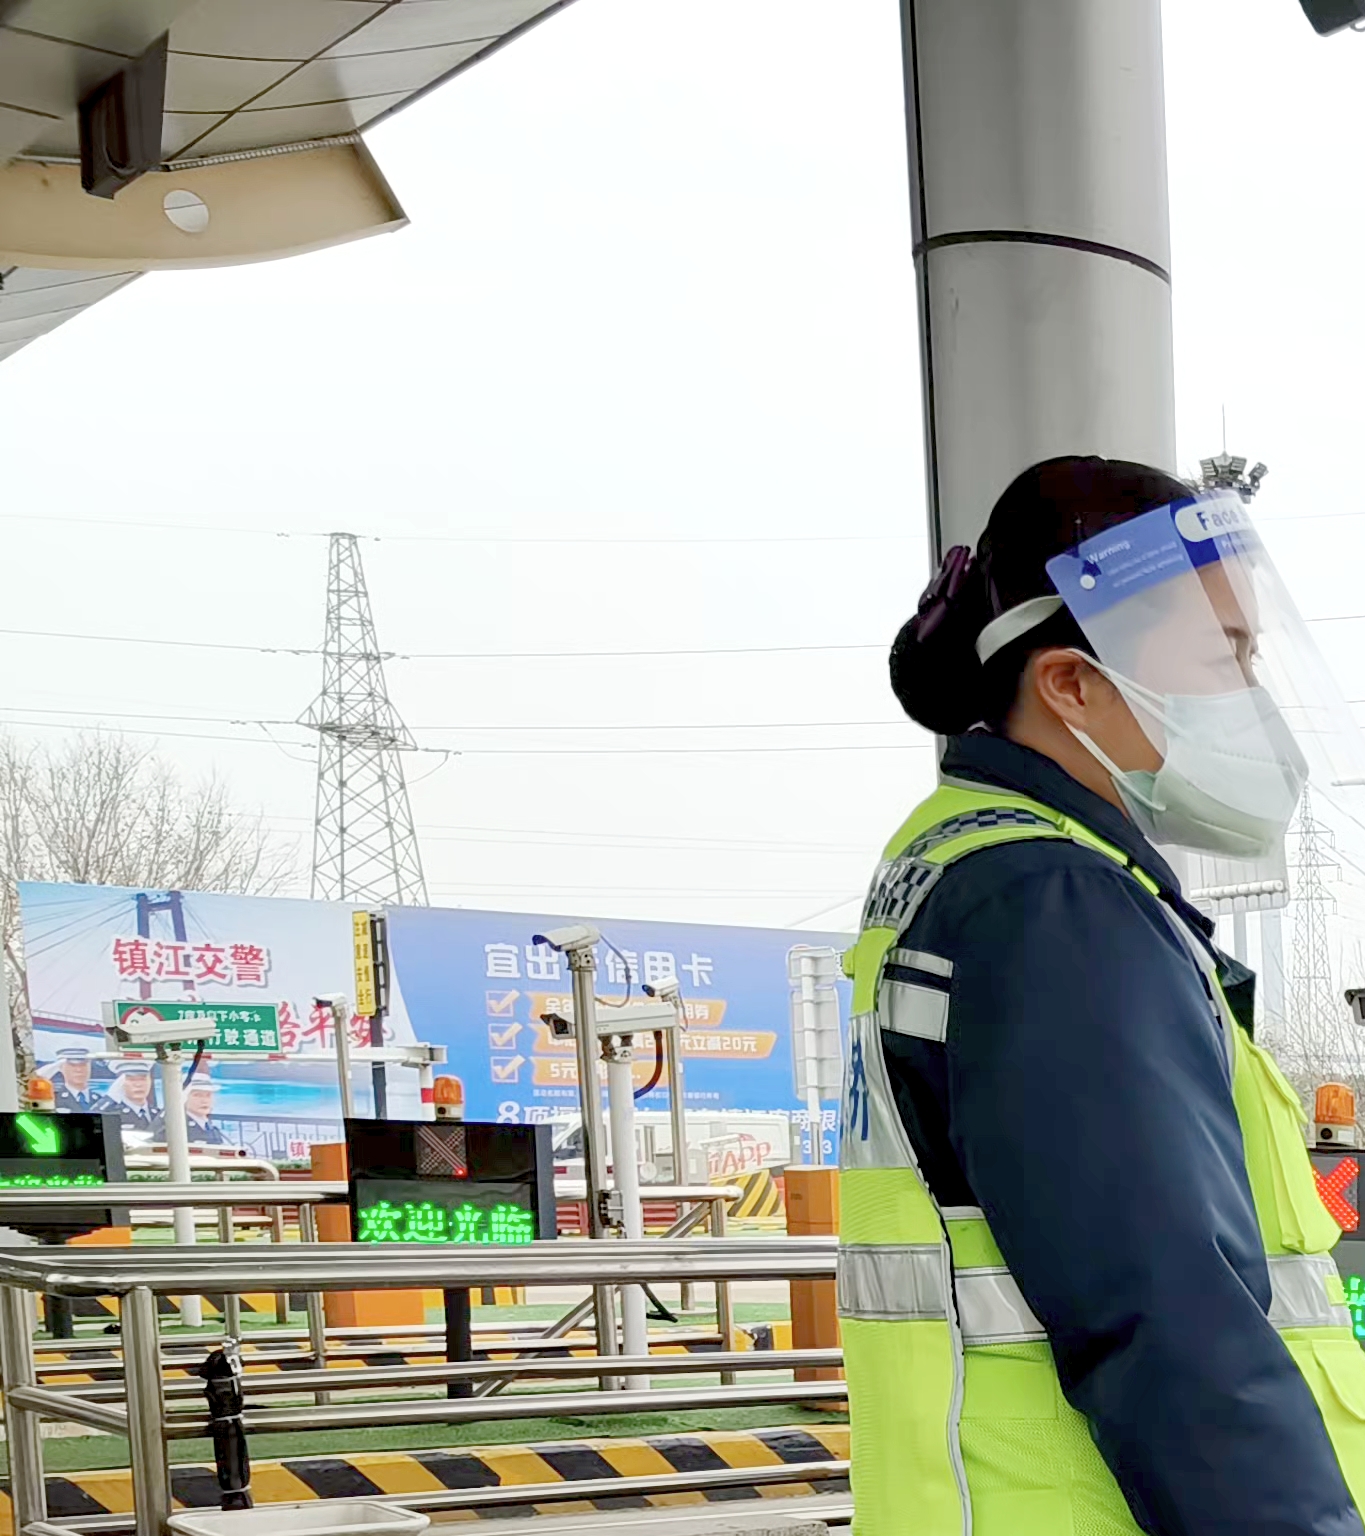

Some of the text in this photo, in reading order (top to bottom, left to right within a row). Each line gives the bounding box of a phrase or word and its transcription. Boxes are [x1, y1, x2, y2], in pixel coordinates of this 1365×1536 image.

[1086, 540, 1131, 565] Warning
[112, 938, 264, 982] 镇江交警
[359, 1201, 535, 1244] 欢迎光临
